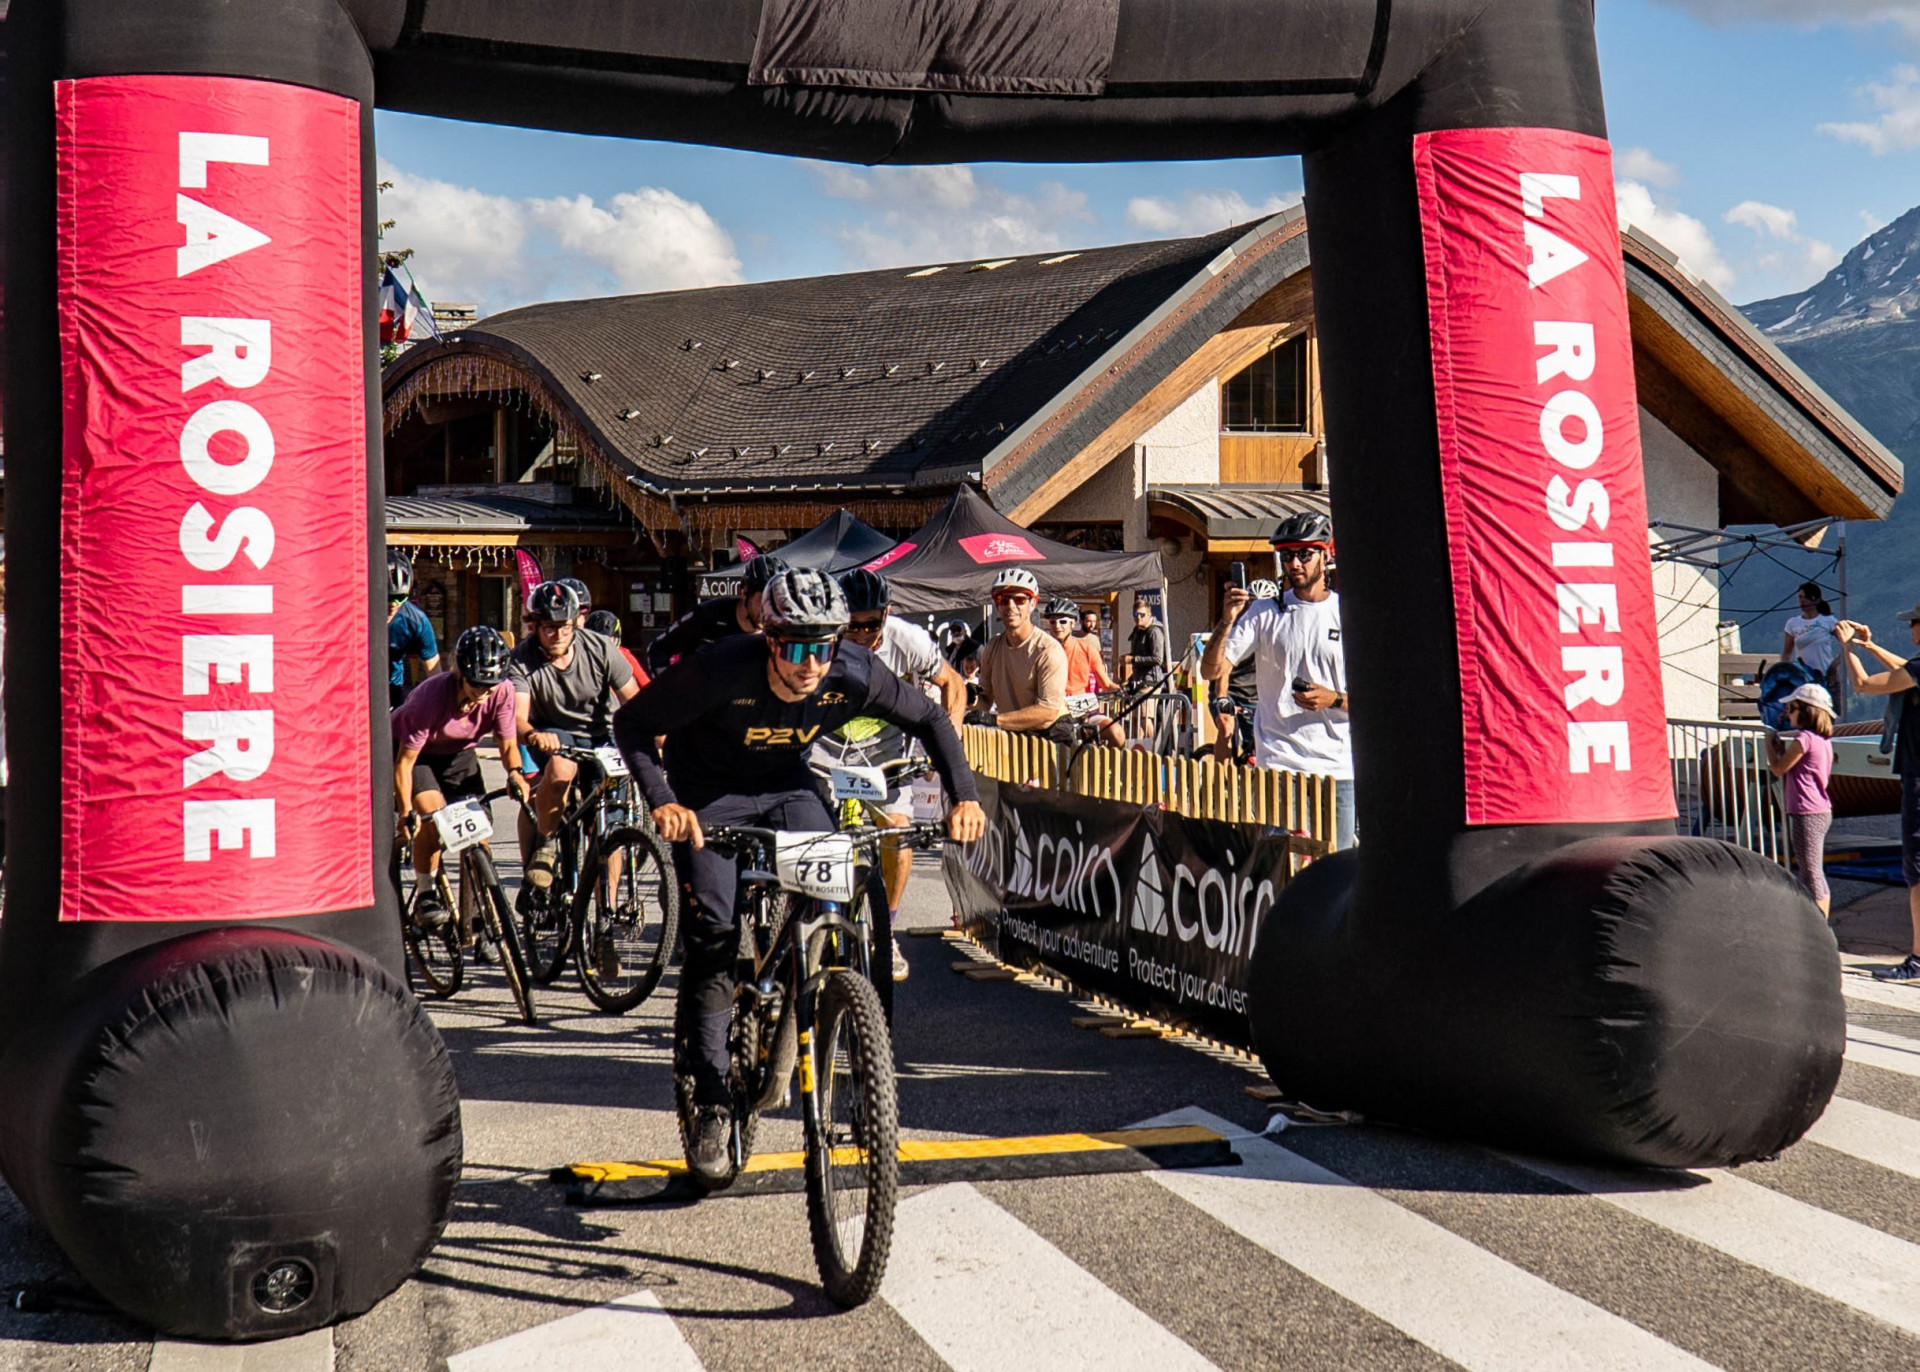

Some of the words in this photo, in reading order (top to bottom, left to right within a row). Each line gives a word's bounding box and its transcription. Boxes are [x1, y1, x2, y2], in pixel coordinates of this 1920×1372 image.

[177, 131, 272, 278] LA
[1519, 172, 1590, 290] LA
[1533, 320, 1632, 774] ROSIERE
[179, 316, 276, 863] ROSIERE
[744, 725, 820, 746] P2V
[845, 776, 872, 789] 75
[452, 818, 477, 838] 76
[797, 861, 832, 883] 78
[1035, 820, 1121, 922] cairn
[1002, 908, 1037, 944] Protect
[1039, 929, 1060, 956] your
[1063, 934, 1119, 973] adventure
[1129, 947, 1176, 993] Protect
[1178, 972, 1208, 1004] your
